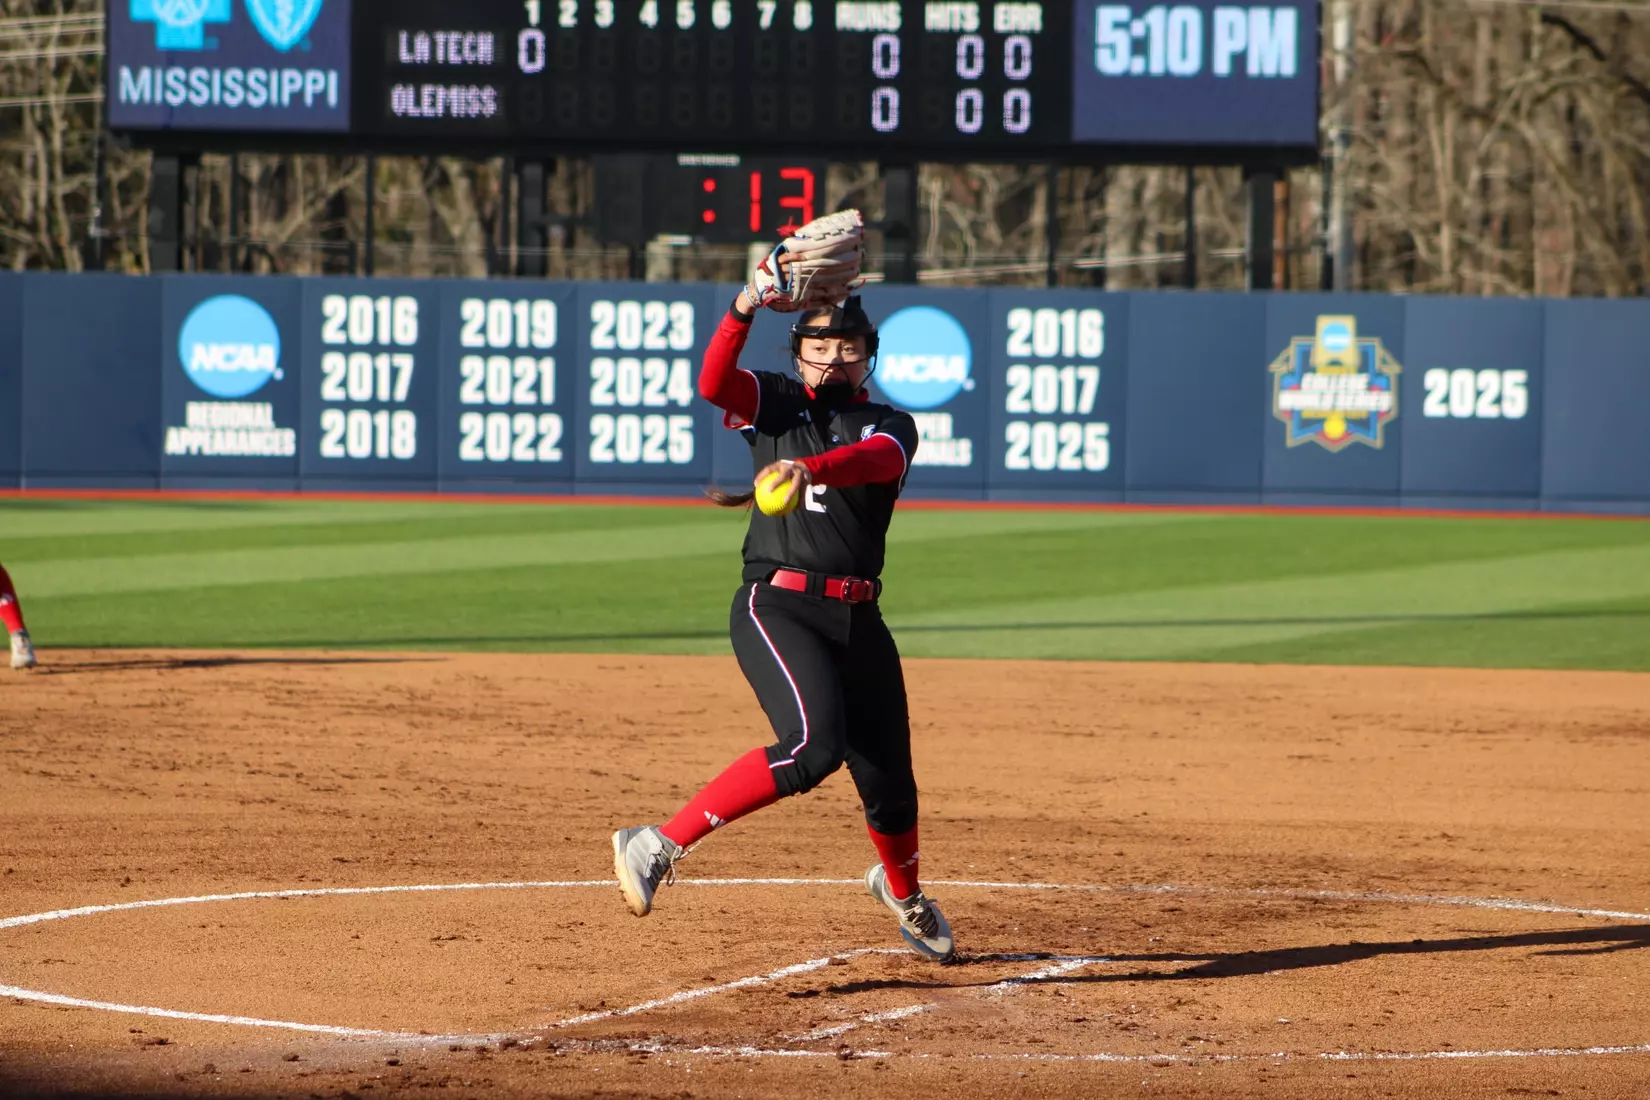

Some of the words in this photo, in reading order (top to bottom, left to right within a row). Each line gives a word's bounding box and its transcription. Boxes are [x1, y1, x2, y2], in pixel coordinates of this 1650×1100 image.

[526, 0, 539, 25] 1
[560, 0, 576, 26] 2
[596, 0, 613, 26] 3
[640, 0, 657, 26] 4
[677, 0, 694, 27] 5
[713, 0, 730, 27] 6
[758, 1, 775, 28] 7
[794, 1, 811, 29] 8
[836, 2, 900, 30] RUNS
[926, 3, 978, 31] HITS
[994, 4, 1041, 31] ERR
[518, 29, 545, 72] 0
[873, 34, 899, 78] 0
[957, 35, 983, 78] 0
[1004, 35, 1031, 79] 0
[1097, 7, 1200, 74] 5:10
[1214, 8, 1295, 75] PM
[120, 67, 336, 106] MISSISSIPPI
[872, 87, 898, 131] 0
[956, 89, 982, 132] 0
[1004, 89, 1030, 132] 0
[323, 296, 417, 344] 2016
[462, 299, 555, 347] 2019
[591, 301, 693, 349] 2023
[1007, 309, 1102, 357] 2016
[191, 344, 274, 371] NCAA
[322, 353, 413, 401] 2017
[461, 356, 554, 403] 2021
[591, 358, 692, 405] 2024
[883, 355, 966, 382] NCAA
[1006, 365, 1098, 413] 2017
[1424, 369, 1526, 417] 2025
[321, 410, 415, 458] 2018
[460, 413, 561, 460] 2022
[590, 415, 692, 462] 2025
[1006, 422, 1108, 470] 2025
